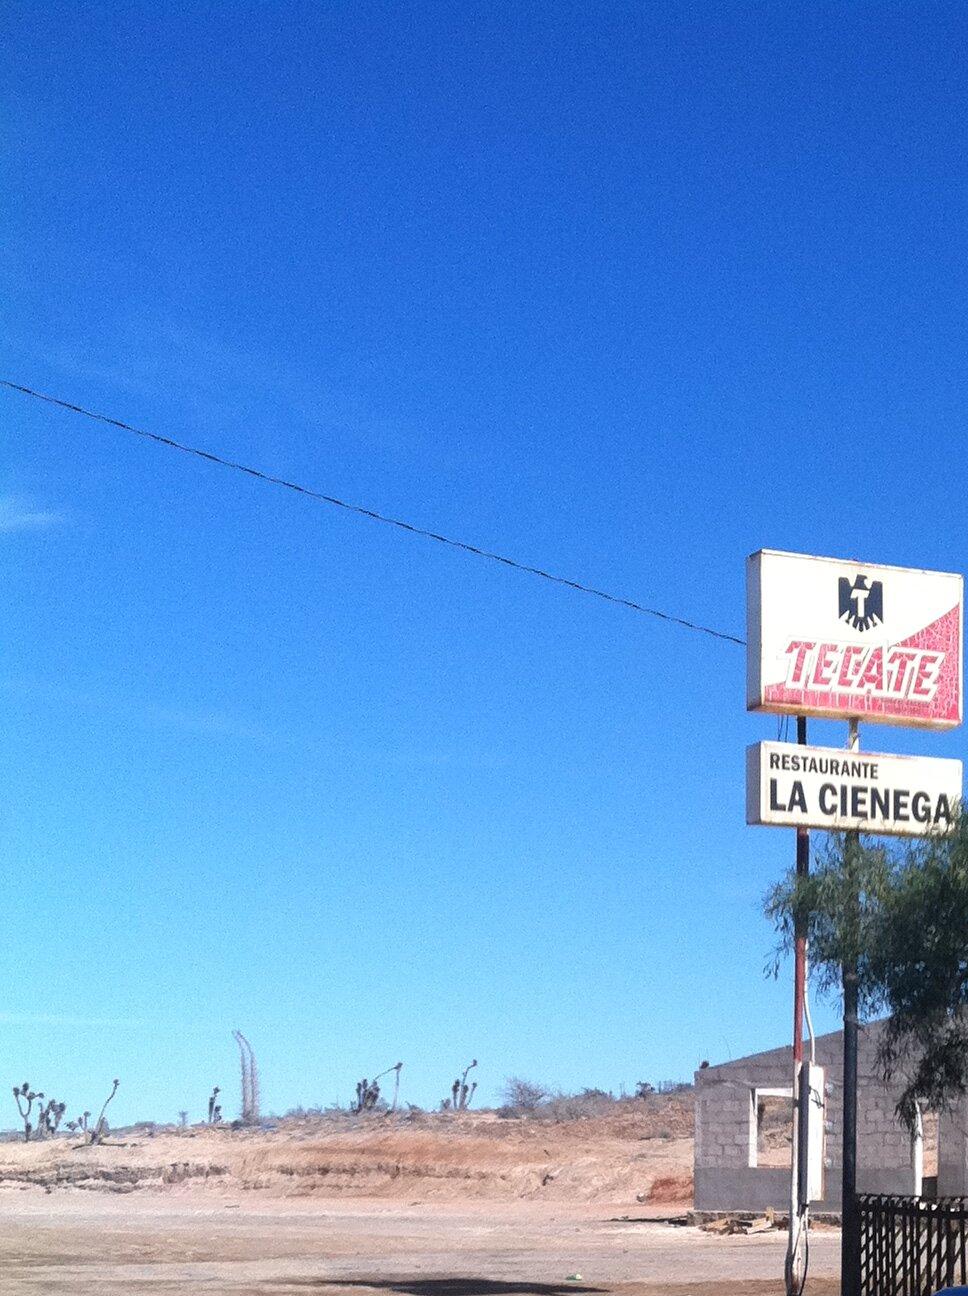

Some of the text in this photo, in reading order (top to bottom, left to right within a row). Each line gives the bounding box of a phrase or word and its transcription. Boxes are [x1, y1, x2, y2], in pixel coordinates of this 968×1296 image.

[785, 640, 942, 698] TECATE
[769, 752, 878, 780] RESTAURANTE
[769, 778, 951, 825] LA CIENEGA
